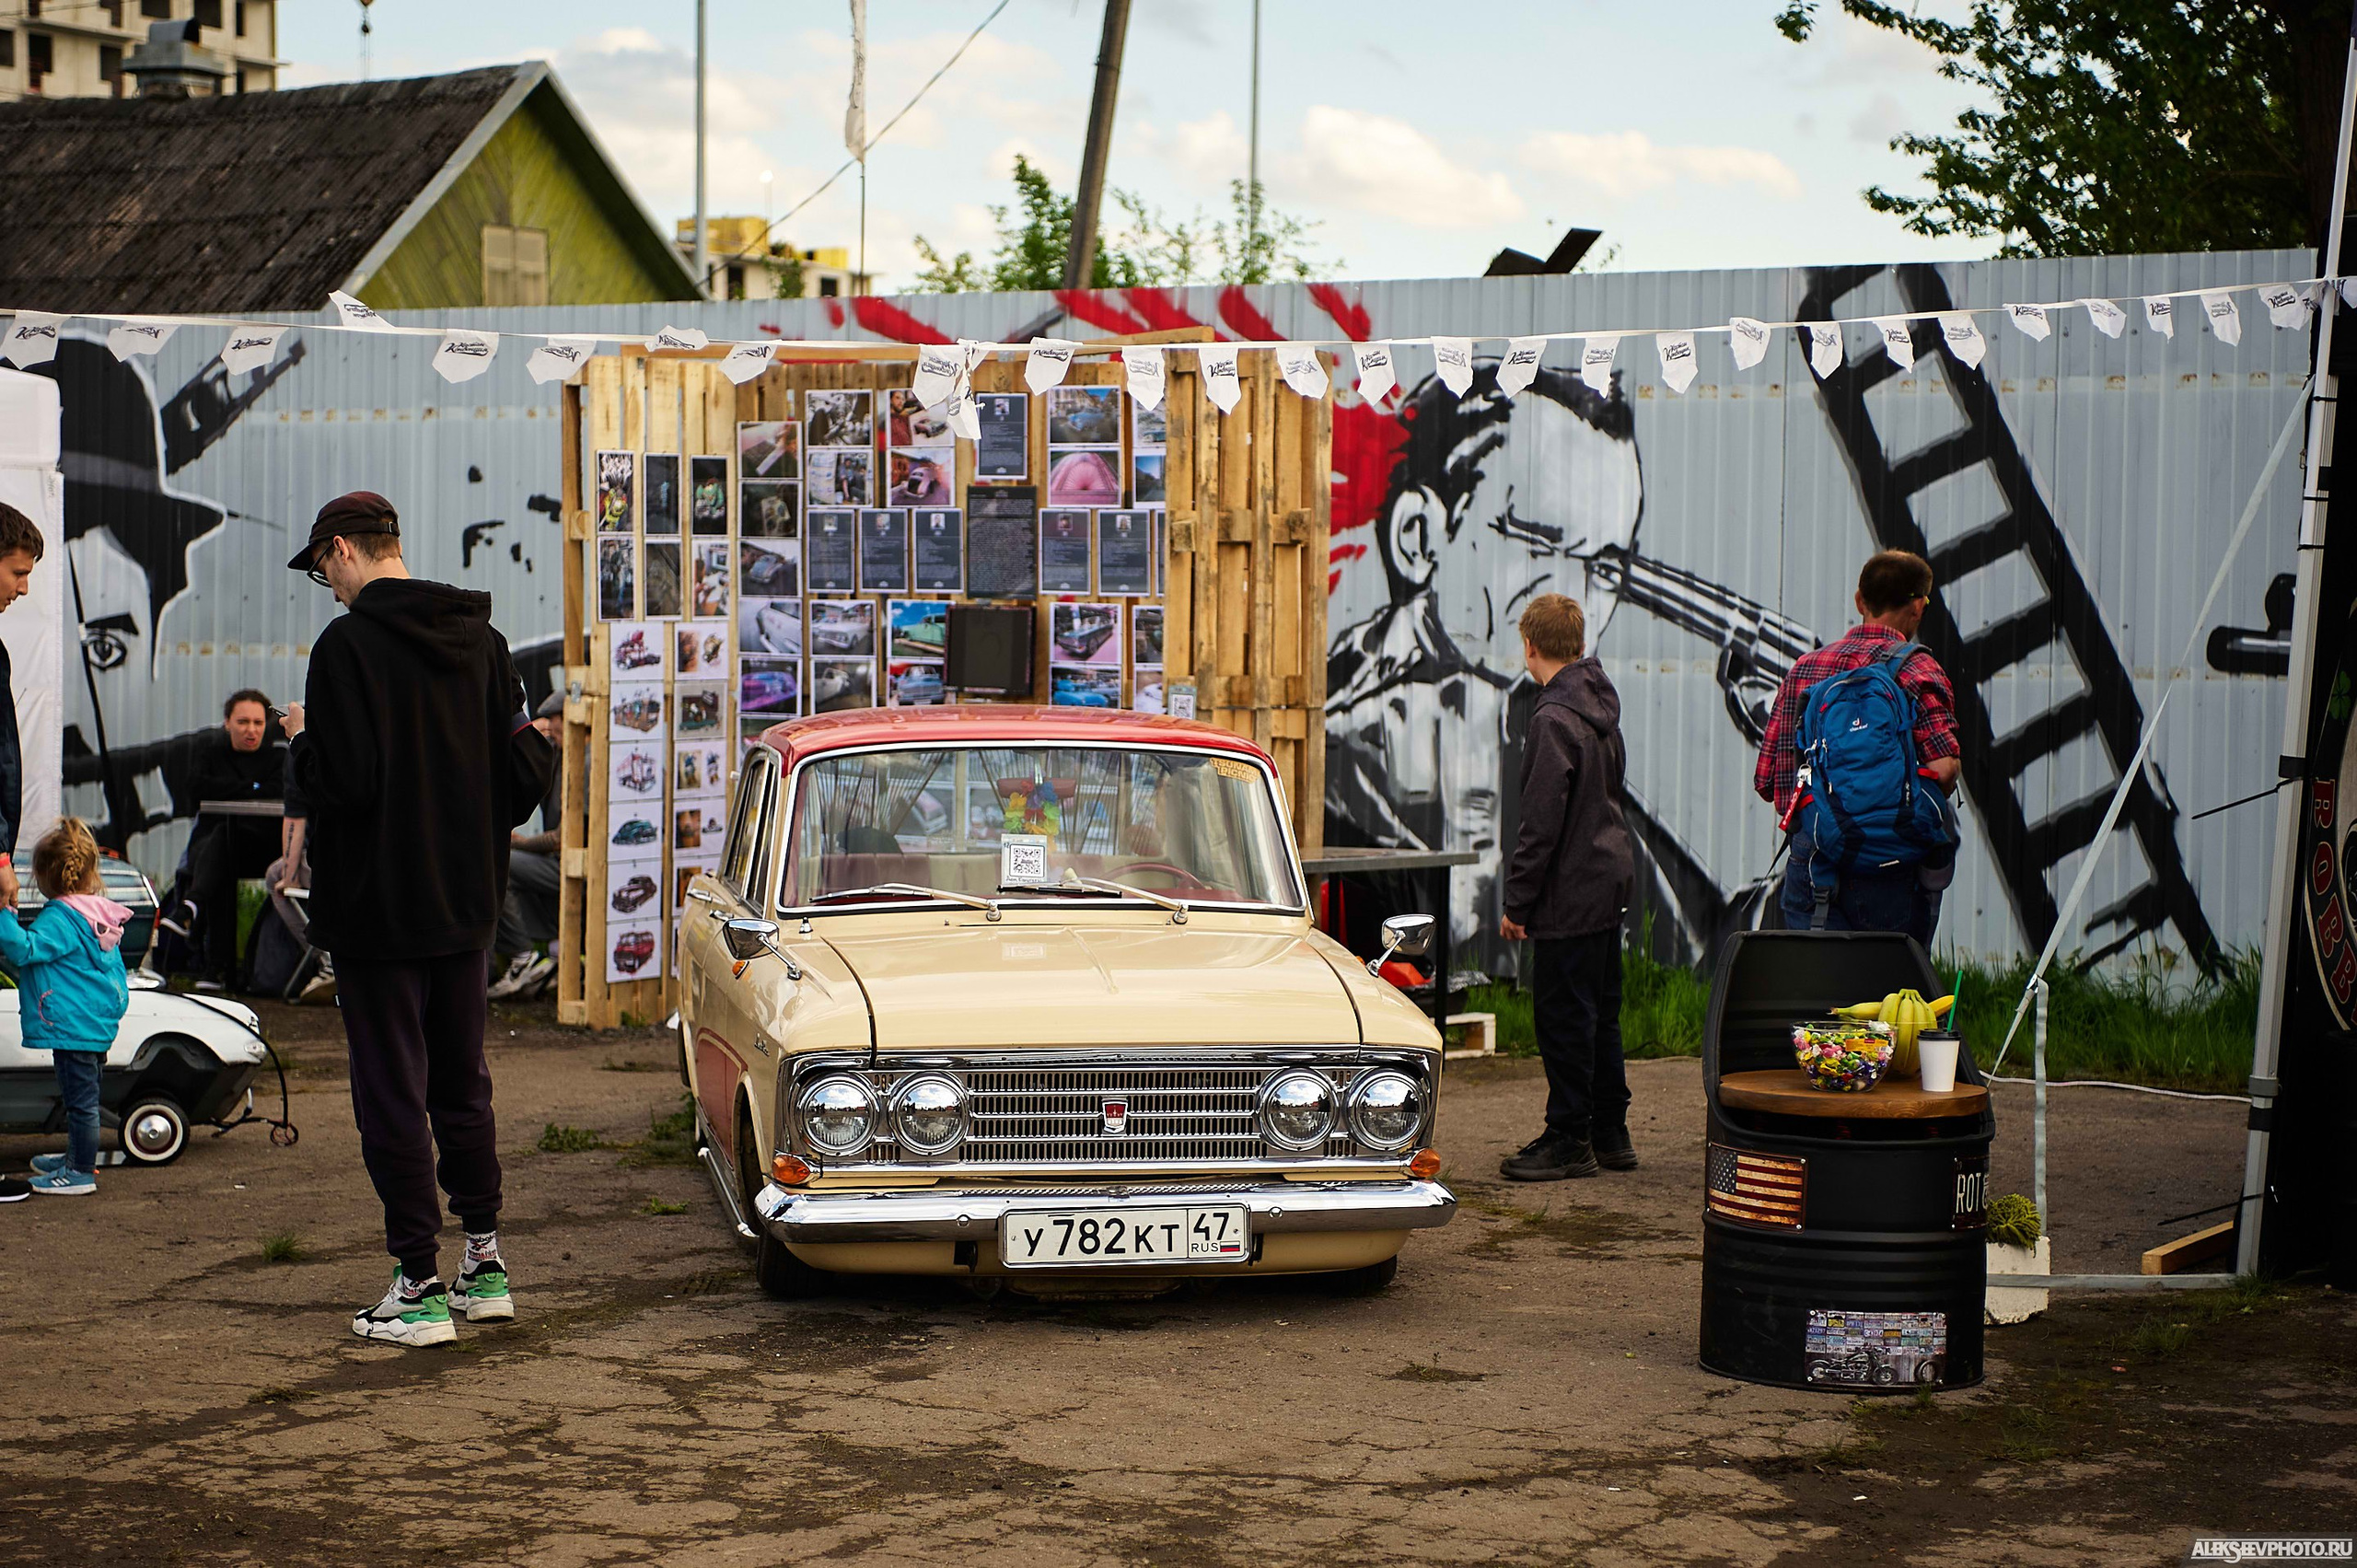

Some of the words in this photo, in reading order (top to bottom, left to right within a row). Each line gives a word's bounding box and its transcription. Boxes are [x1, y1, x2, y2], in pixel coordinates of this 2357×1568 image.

[1220, 767, 1256, 781] PICNIC
[1193, 1213, 1230, 1241] 47
[1191, 1242, 1219, 1253] RUS
